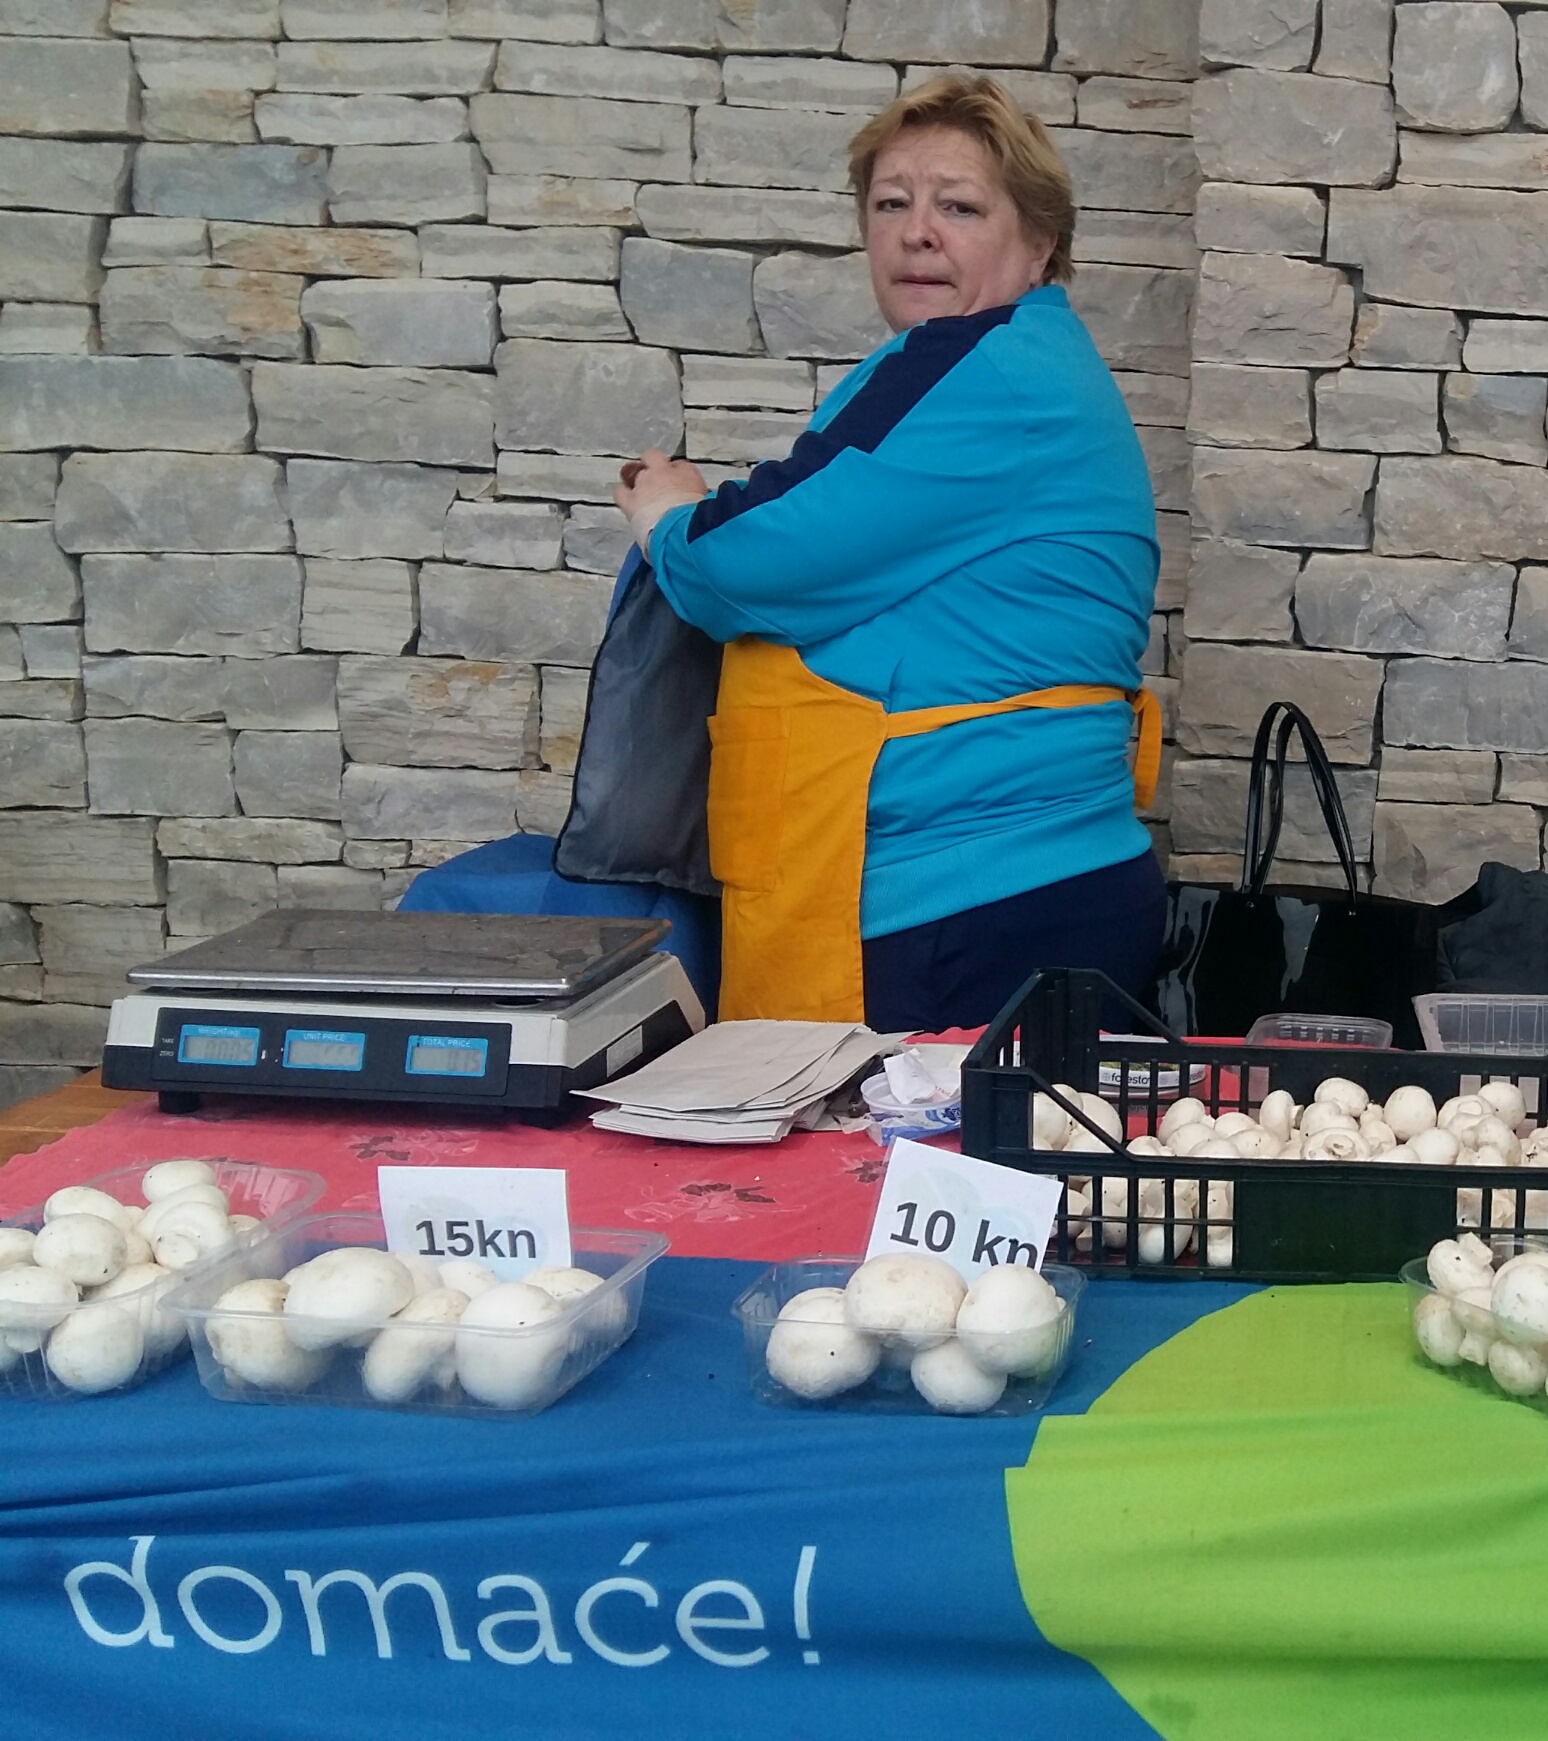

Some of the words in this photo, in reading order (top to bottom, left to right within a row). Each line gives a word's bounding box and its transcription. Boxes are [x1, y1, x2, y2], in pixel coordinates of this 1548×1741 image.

[303, 1032, 320, 1041] UNIT
[322, 1033, 346, 1042] PRICE
[422, 1038, 445, 1046] TOTAL
[447, 1039, 471, 1048] PRICE
[1111, 1072, 1150, 1085] foesto
[415, 1219, 537, 1259] 15kn
[889, 1201, 956, 1253] 10
[971, 1218, 1038, 1270] kn
[63, 1534, 821, 1668] domaće!
